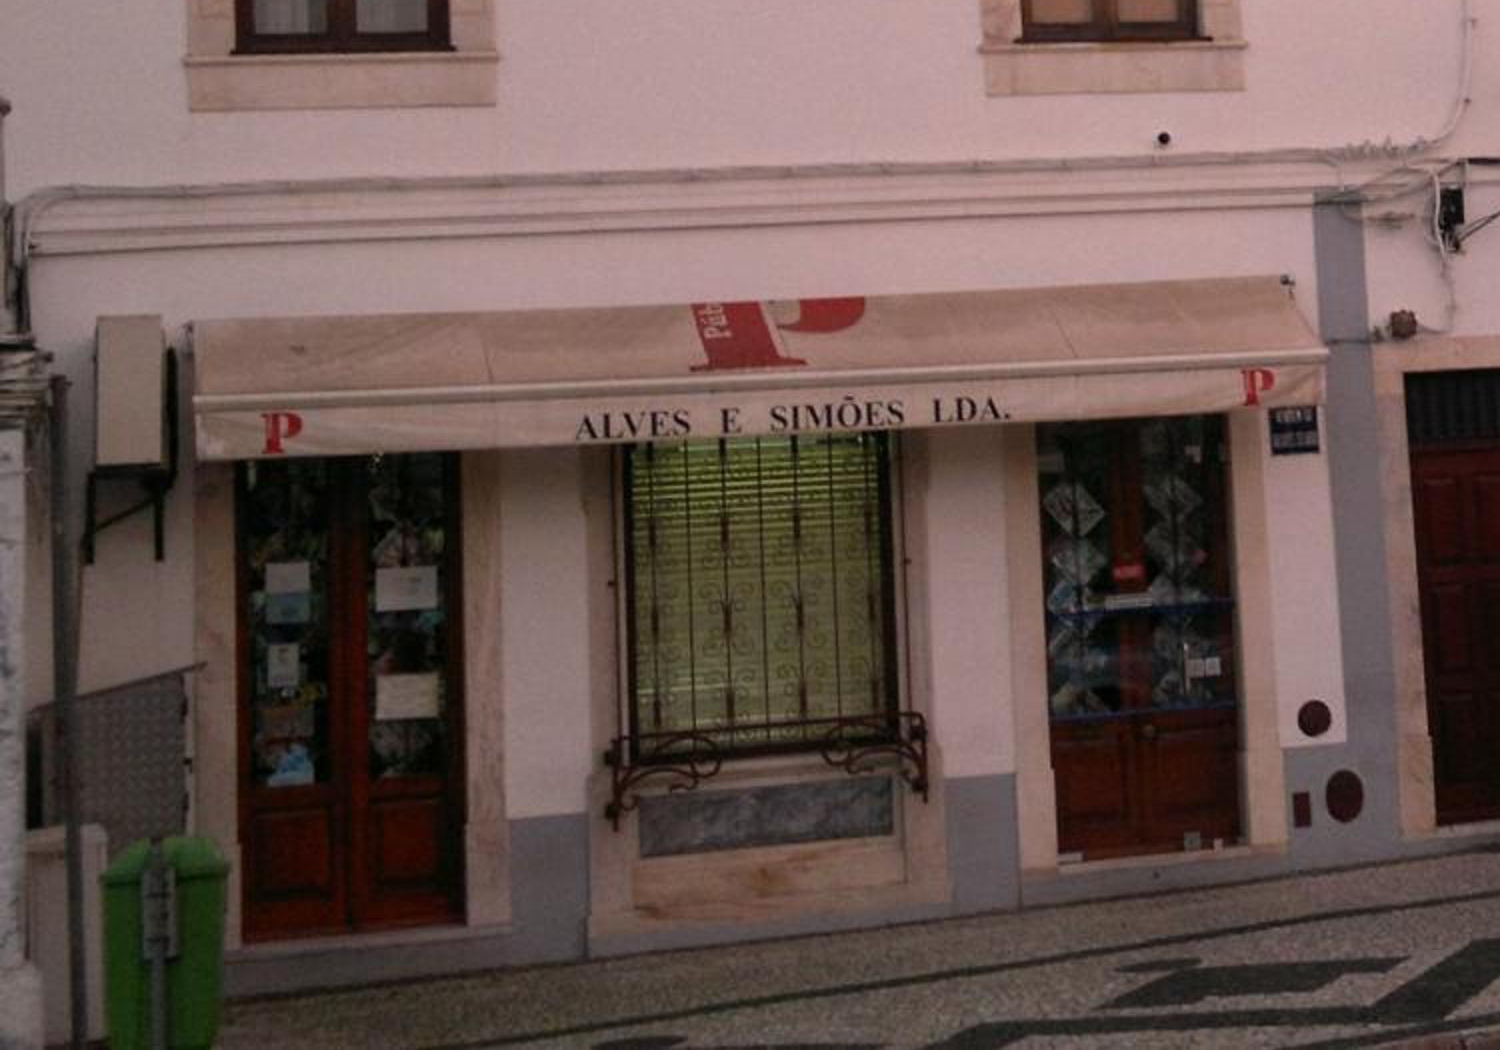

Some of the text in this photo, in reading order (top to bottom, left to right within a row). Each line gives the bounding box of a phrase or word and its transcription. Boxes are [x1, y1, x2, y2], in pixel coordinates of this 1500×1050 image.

[1241, 369, 1275, 406] P
[262, 413, 302, 454] P
[575, 395, 1012, 440] ALVES E SIMÕES LDA.
